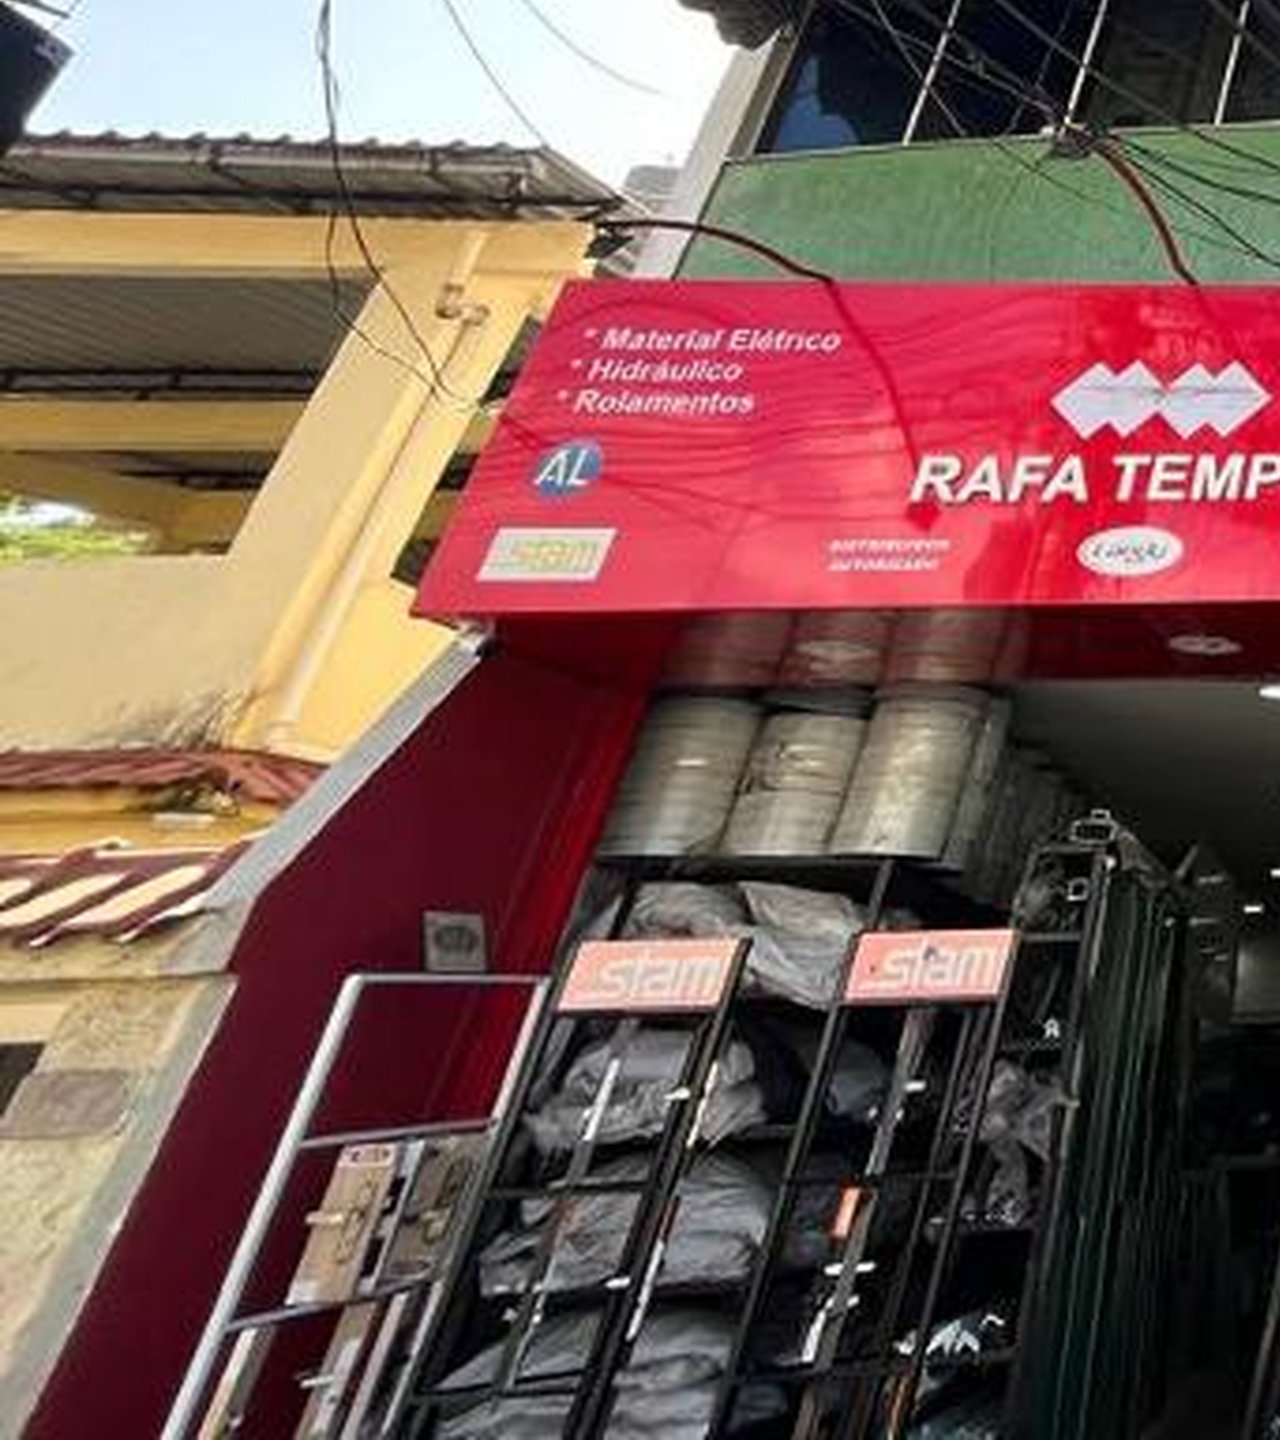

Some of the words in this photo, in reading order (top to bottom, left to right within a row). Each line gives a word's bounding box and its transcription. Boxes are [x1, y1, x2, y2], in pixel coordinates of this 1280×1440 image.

[601, 328, 720, 351] Material
[729, 328, 841, 351] Elétrico
[587, 359, 743, 381] Hidráulico
[574, 389, 755, 413] Rolamentos
[908, 454, 1088, 503] RAFA
